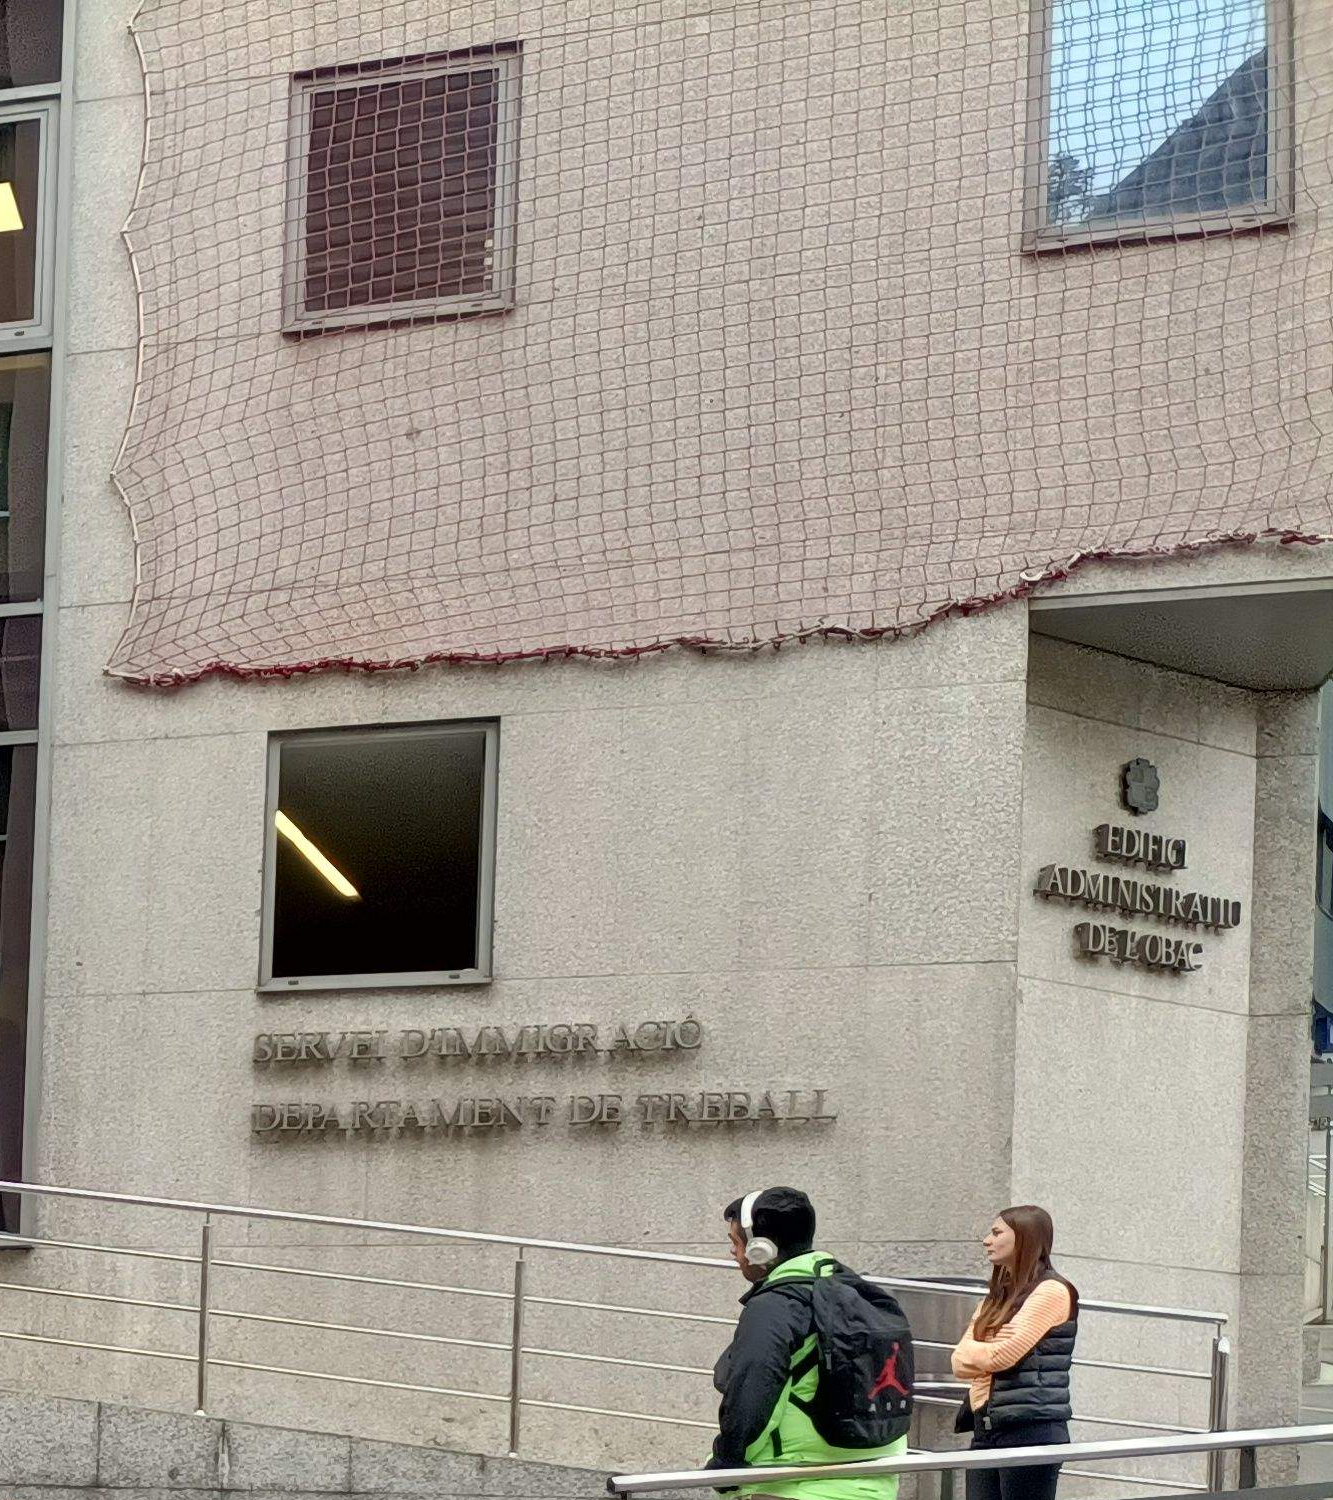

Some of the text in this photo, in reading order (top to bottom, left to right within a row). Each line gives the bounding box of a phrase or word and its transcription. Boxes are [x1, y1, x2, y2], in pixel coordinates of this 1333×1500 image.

[1098, 823, 1189, 869] EDIFICI
[1035, 863, 1242, 929] ADMINISTRATIU
[1078, 921, 1120, 958] DE
[252, 1014, 703, 1063] SERVEI D'IMMIGRACIÓ
[251, 1088, 837, 1133] DEPARTAMENT DE TREBALL
